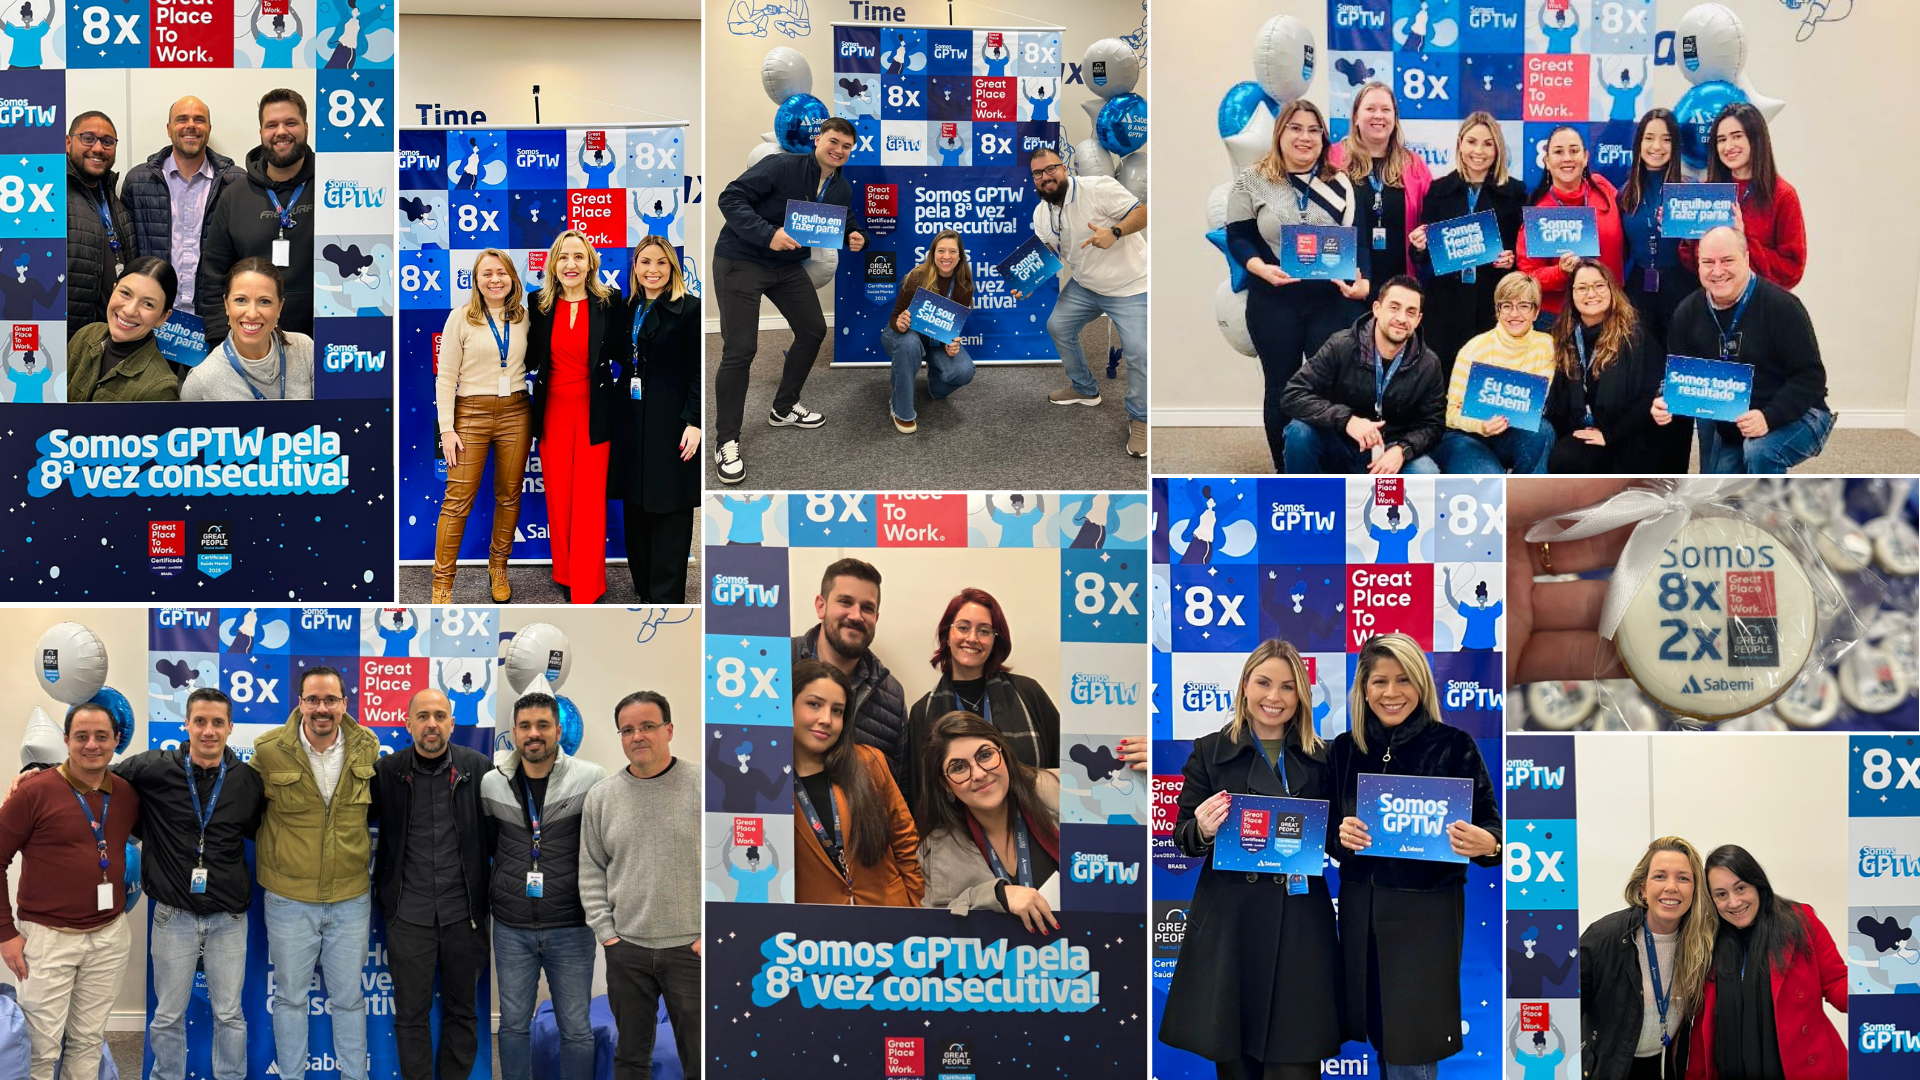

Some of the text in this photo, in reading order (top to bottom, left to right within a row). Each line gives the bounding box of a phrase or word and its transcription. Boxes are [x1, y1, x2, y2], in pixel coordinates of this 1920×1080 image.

[157, 7, 212, 24] Place
[849, 1, 906, 22] Time
[1337, 11, 1385, 27] GPTW
[1601, 2, 1647, 34] 8x
[82, 6, 141, 45] 8x
[1470, 12, 1517, 29] GPTW
[156, 26, 178, 43] To
[840, 46, 875, 57] GPTW
[934, 49, 968, 59] GPTW
[1024, 42, 1056, 64] 8x
[1528, 58, 1573, 72] Great
[975, 79, 1006, 89] Great
[1403, 68, 1449, 101] 8x
[1529, 73, 1573, 87] Place
[887, 85, 921, 107] 8x
[976, 89, 1006, 99] Place
[1528, 88, 1546, 102] To
[328, 90, 385, 127] 8x
[975, 99, 987, 108] To
[0, 105, 56, 124] GPTW
[416, 103, 487, 126] Time
[980, 133, 1013, 154] 8x
[399, 155, 440, 169] GPTW
[516, 154, 560, 168] GPTW
[635, 142, 677, 170] 8x
[328, 179, 359, 188] Somos
[0, 175, 54, 213] 8x
[327, 187, 387, 206] GPTW
[571, 193, 612, 204] Great
[915, 187, 1024, 203] Somos GPTW
[572, 206, 612, 218] Place
[915, 202, 1005, 222] pela 8ª vez
[1669, 198, 1731, 211] Orgulho em
[458, 205, 500, 232] 8x
[791, 212, 842, 227] Orgulho em
[1538, 218, 1583, 230] Somos
[1700, 210, 1729, 221] parte
[572, 219, 587, 231] To
[792, 220, 815, 232] fazer
[915, 217, 1017, 235] consecutiva!
[1441, 222, 1481, 239] Somos
[1444, 230, 1485, 248] Mental
[1542, 229, 1581, 242] GPTW
[1010, 250, 1040, 275] Somos
[1018, 257, 1045, 281] GPTW
[400, 265, 441, 292] 8x
[975, 280, 1005, 293] vez
[922, 300, 956, 322] Eu sou
[916, 308, 955, 332] Sabemi
[175, 336, 204, 351] parte
[327, 343, 358, 352] Somos
[326, 351, 386, 369] GPTW
[1484, 377, 1531, 399] Eu sou
[1670, 371, 1746, 393] Somos todos
[1478, 389, 1531, 412] Sabemi
[1679, 385, 1735, 401] resultado
[50, 425, 340, 462] Somos GPTW pela
[41, 455, 350, 489] 8ª vez consecutiva!
[806, 494, 867, 522] 8x
[883, 504, 906, 521] To
[1272, 502, 1305, 512] Somos
[1448, 494, 1503, 535] 8x
[151, 523, 176, 531] Great
[1271, 511, 1336, 531] GPTW
[151, 531, 176, 539] Place
[151, 538, 161, 546] To
[1660, 539, 1774, 568] Somos
[716, 574, 749, 585] Somos
[1352, 569, 1412, 587] Great
[1728, 575, 1762, 584] Great
[715, 584, 779, 604] GPTW
[1074, 572, 1139, 615] 8x
[1658, 572, 1721, 612] 8x
[1730, 584, 1762, 593] Place
[1184, 586, 1246, 626] 8x
[1353, 590, 1411, 607] Place
[1730, 594, 1743, 603] To
[159, 611, 211, 627] GPTW
[301, 615, 352, 630] GPTW
[442, 608, 490, 637] 8x
[1352, 610, 1375, 626] To
[1659, 619, 1723, 661] 2x
[1734, 645, 1773, 653] PEOPLE
[364, 661, 412, 675] Great
[365, 677, 411, 691] Place
[716, 657, 779, 699] 8x
[1075, 672, 1109, 683] Somos
[1187, 681, 1219, 690] Somos
[1448, 680, 1479, 690] Somos
[1704, 678, 1754, 691] Sabemi
[230, 670, 280, 704] 8x
[1074, 682, 1141, 704] GPTW
[364, 692, 382, 706] To
[1863, 748, 1920, 790] 8x
[1151, 806, 1167, 818] To
[1380, 793, 1449, 816] Somos
[1383, 813, 1445, 836] GPTW
[1075, 851, 1108, 862] Somos
[1406, 845, 1425, 853] Sabemi
[1863, 846, 1896, 856] Somos
[1074, 861, 1139, 881] GPTW
[1506, 842, 1564, 883] 8x
[775, 932, 1090, 977] Somos GPTW pela
[766, 966, 1100, 1004] 8ª vez consecutiva!
[1863, 1022, 1896, 1032] Somos
[888, 1040, 915, 1048] Great
[889, 1048, 915, 1057] Place
[888, 1057, 899, 1065] To
